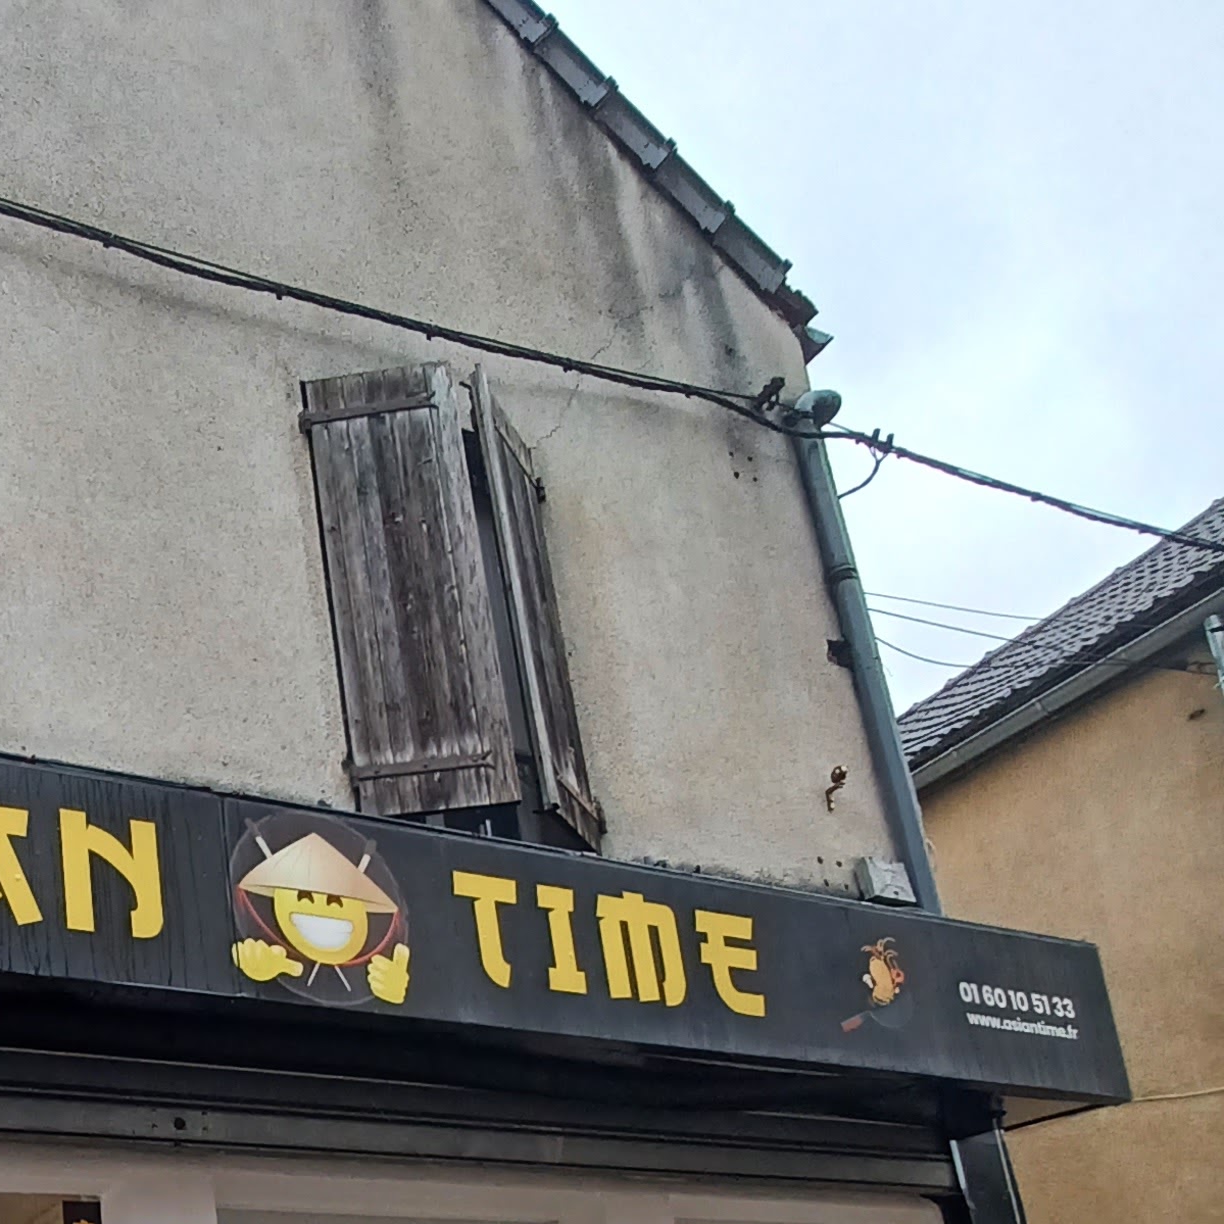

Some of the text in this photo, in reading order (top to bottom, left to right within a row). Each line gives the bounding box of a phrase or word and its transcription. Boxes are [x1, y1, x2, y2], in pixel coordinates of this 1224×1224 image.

[452, 869, 766, 1018] TIME
[958, 981, 1075, 1019] 01 60 10 51 33
[966, 1012, 1079, 1039] www.asiantime.fr
